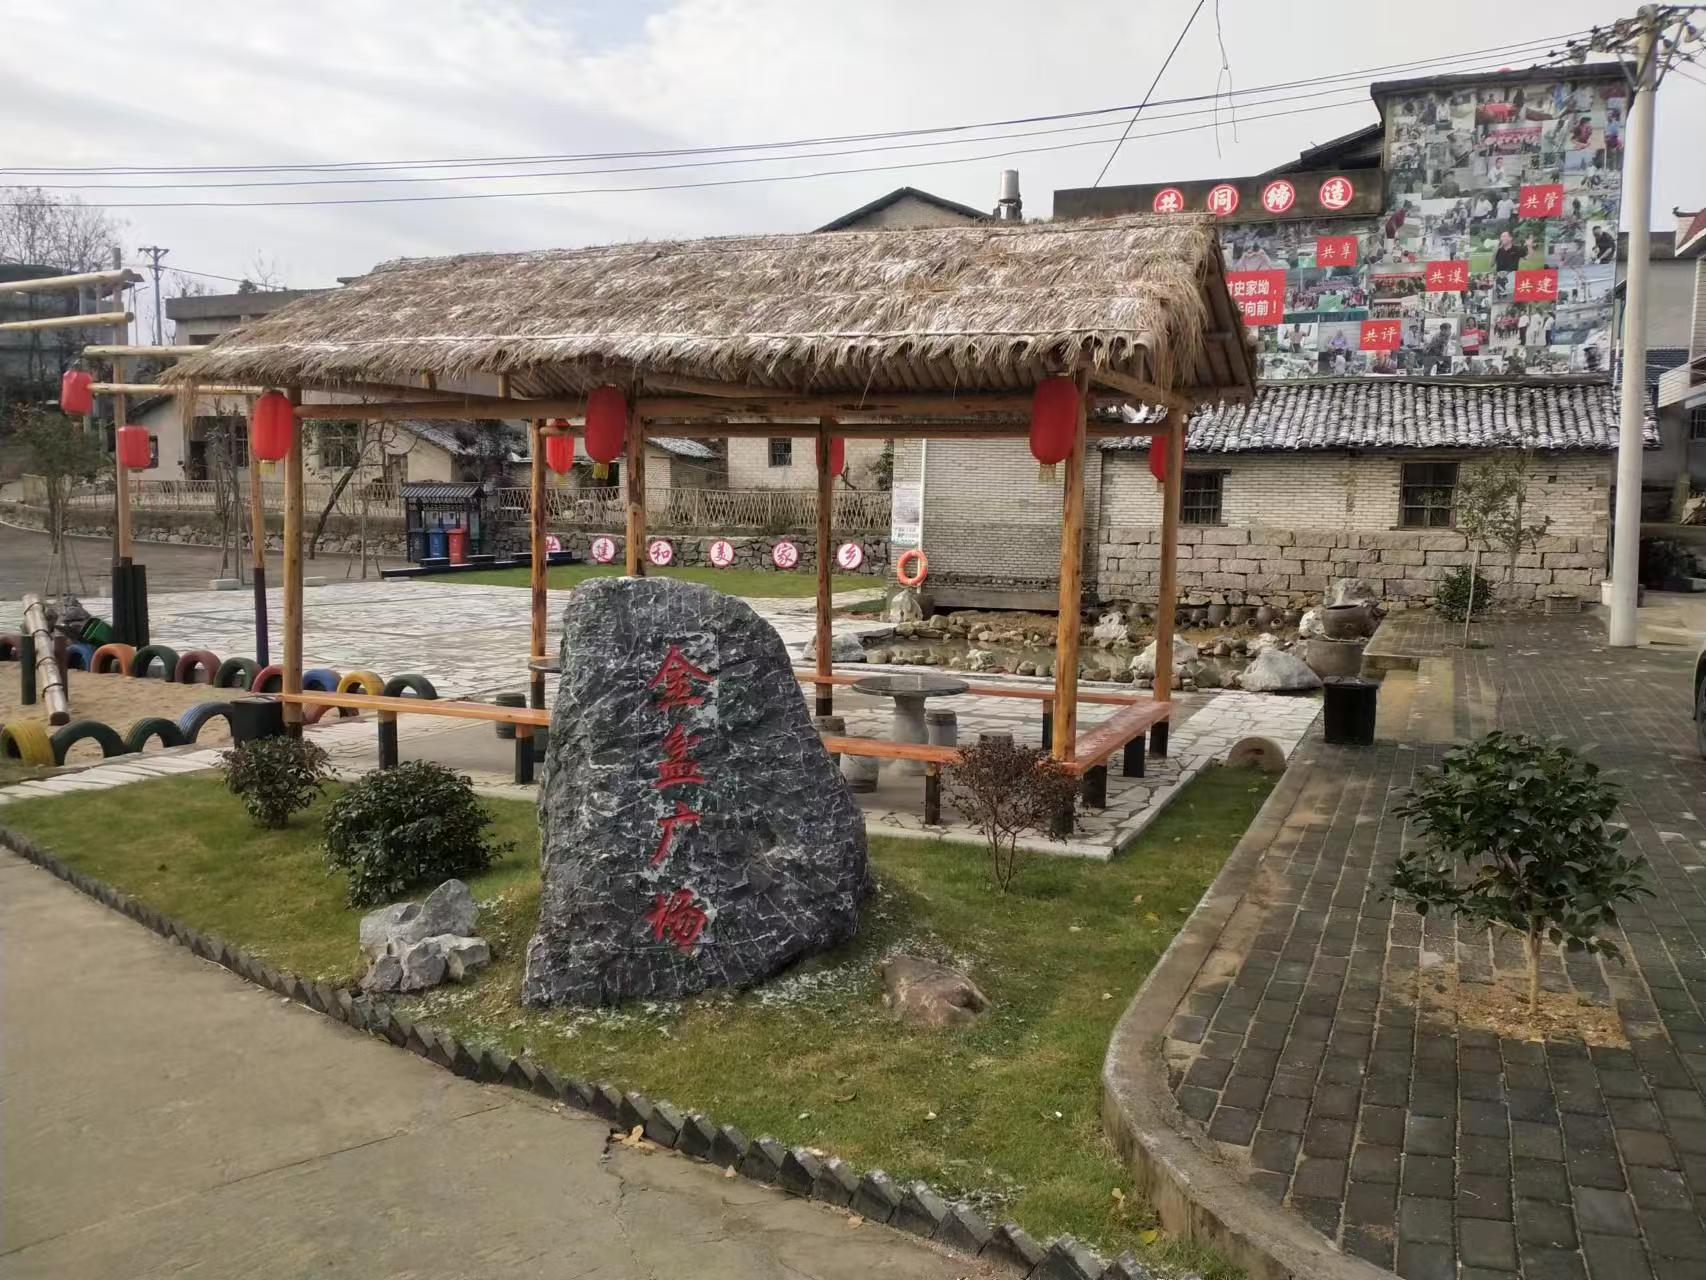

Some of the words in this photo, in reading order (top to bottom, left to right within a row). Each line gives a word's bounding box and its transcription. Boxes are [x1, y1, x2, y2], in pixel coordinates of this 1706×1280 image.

[1157, 176, 1348, 212] 共同缔造
[1523, 192, 1559, 211] 共管
[1320, 240, 1352, 260] 共享
[1429, 267, 1466, 284] 共谋
[1517, 277, 1555, 294] 共建
[1363, 327, 1397, 344] 共评
